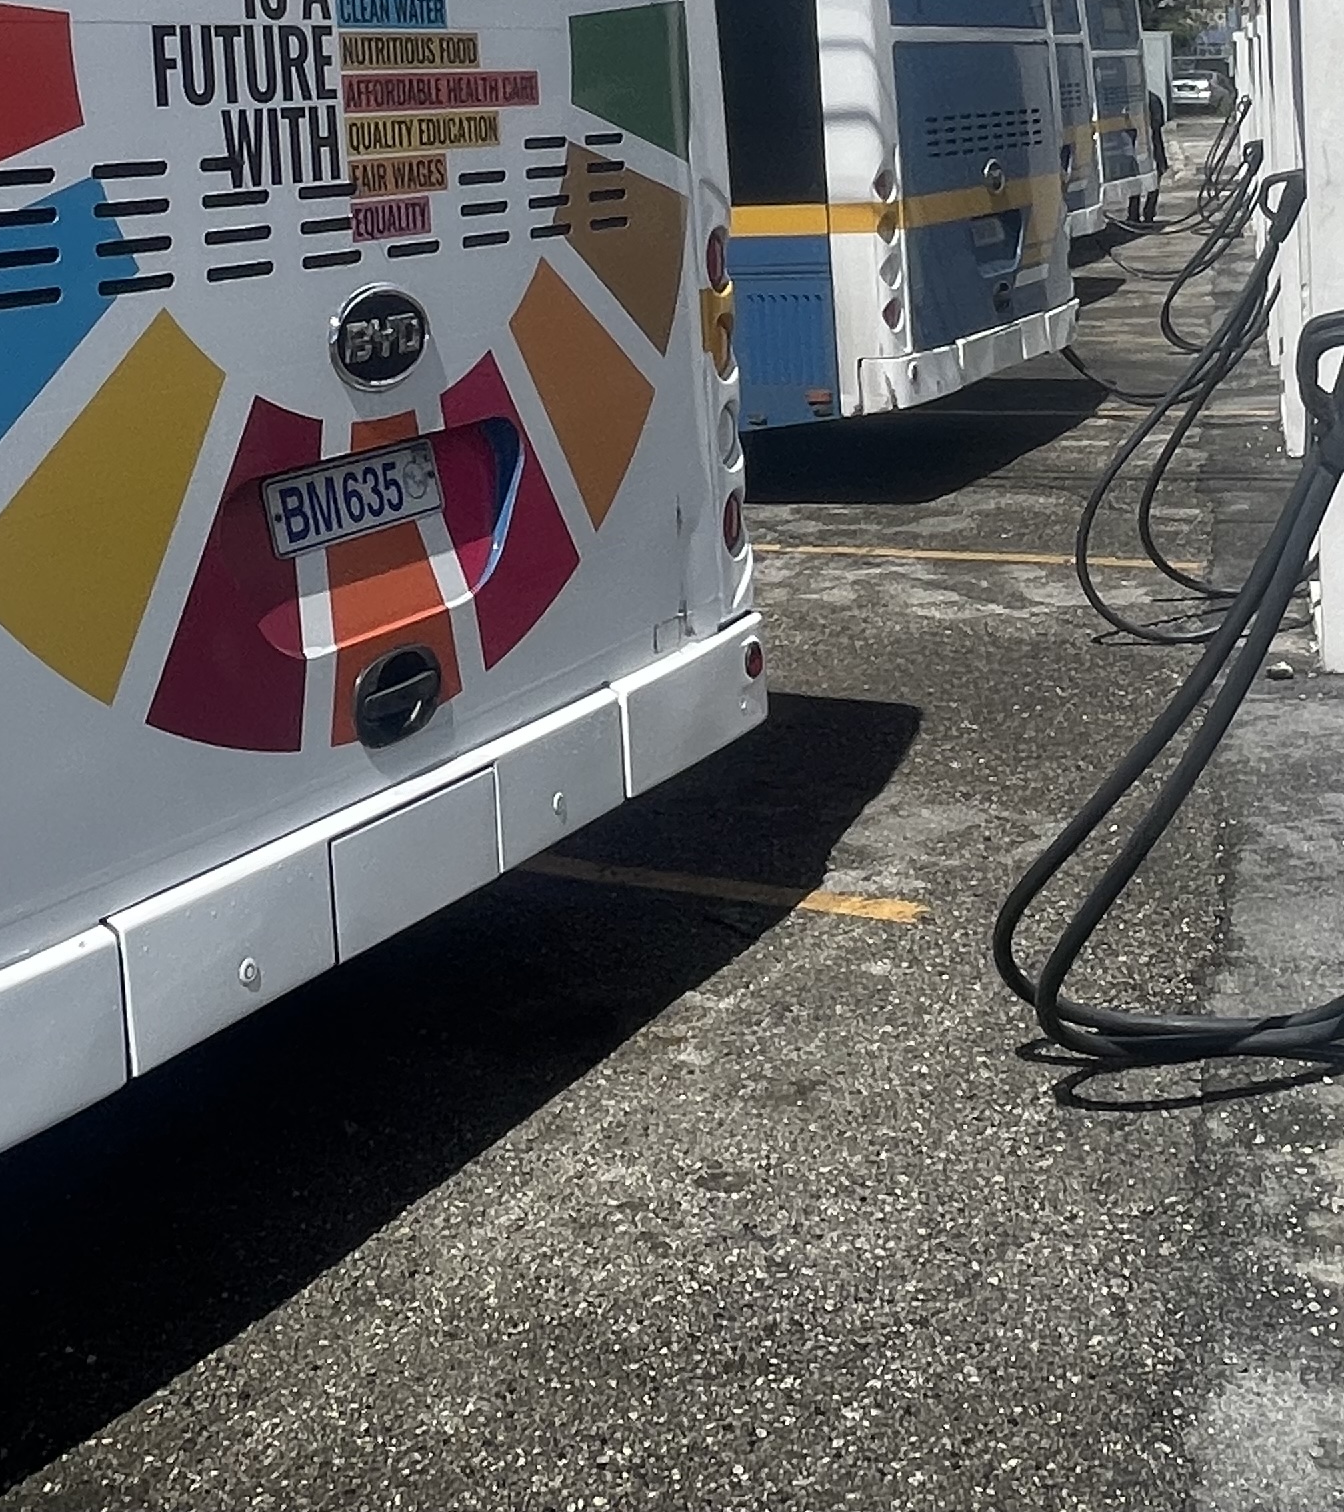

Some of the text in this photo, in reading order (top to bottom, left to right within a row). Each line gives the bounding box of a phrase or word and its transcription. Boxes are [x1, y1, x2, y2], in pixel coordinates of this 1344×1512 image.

[152, 24, 337, 107] FUTURE
[342, 36, 477, 65] NUTRITIOUS FOOD
[346, 74, 536, 108] AFFORDABLE HEALTH CARE
[221, 106, 341, 189] WITH
[349, 115, 499, 154] QUALITY EDUCATION
[351, 158, 445, 192] FAIR WAGES
[354, 202, 426, 239] EQUALITY
[345, 312, 420, 364] BYD
[279, 462, 403, 544] BM635
